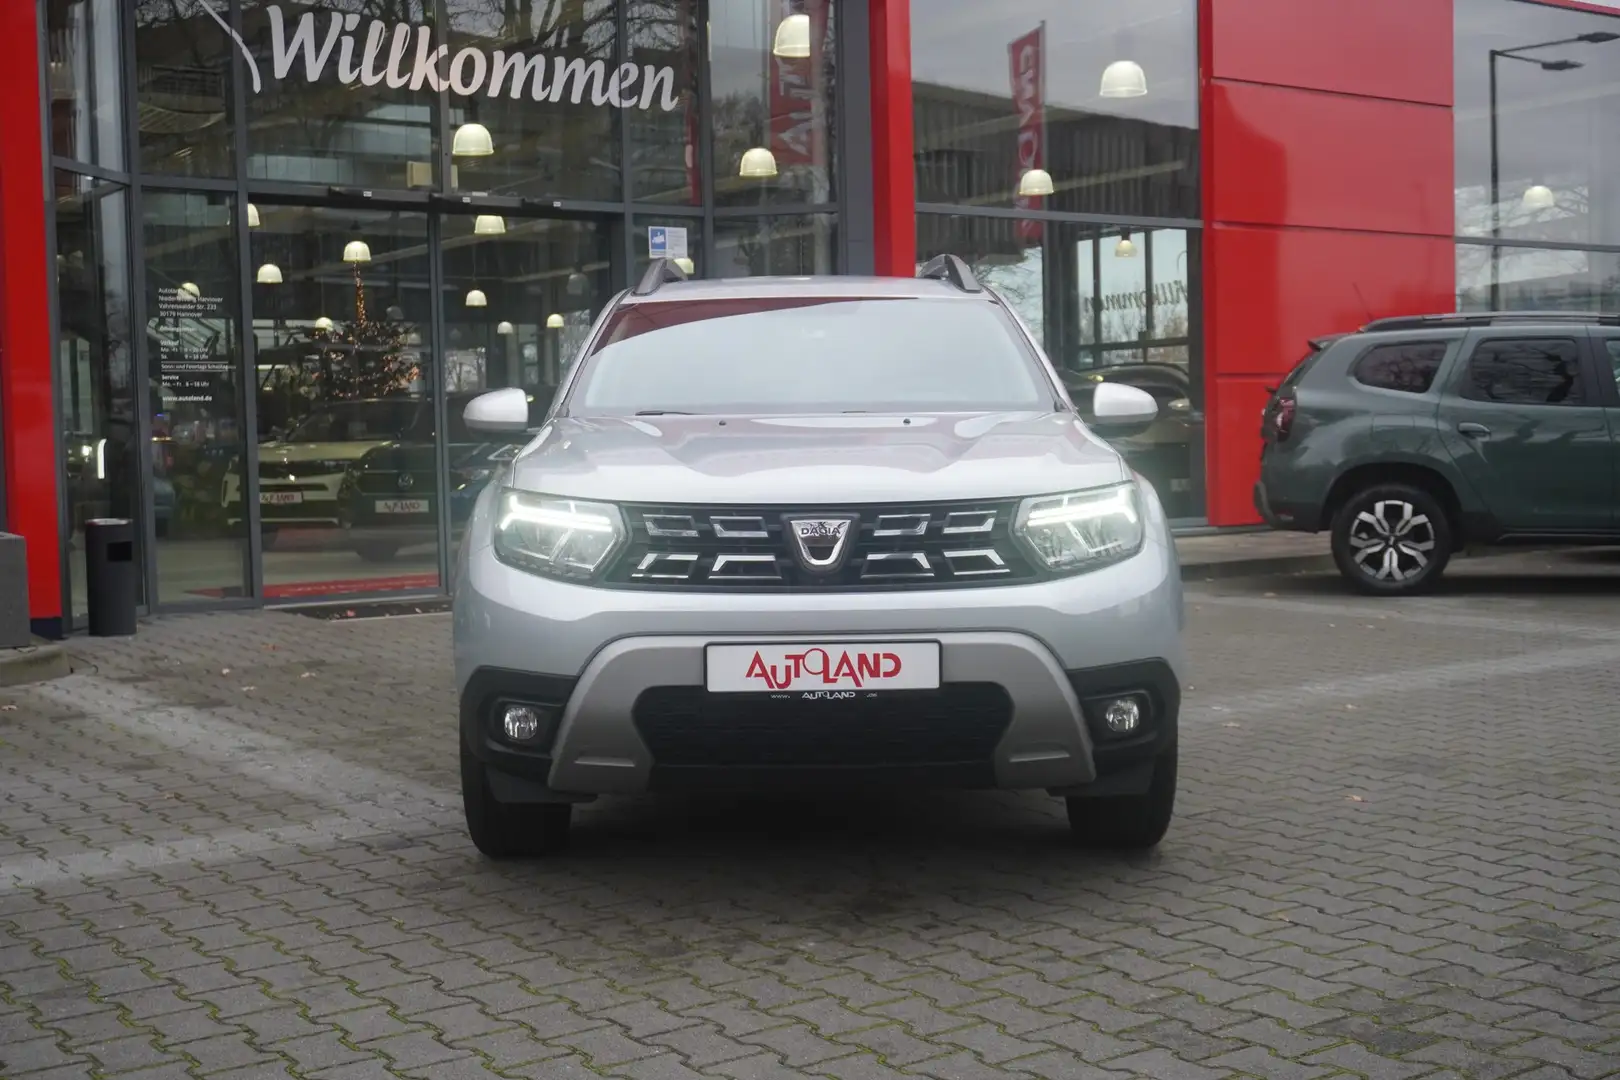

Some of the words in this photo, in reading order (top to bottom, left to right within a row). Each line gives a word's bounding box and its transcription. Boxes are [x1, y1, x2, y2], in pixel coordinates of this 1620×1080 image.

[266, 4, 679, 112] Willkommen
[162, 394, 213, 402] www.autoland.de
[745, 647, 902, 690] AUTOLAND
[802, 690, 856, 700] AUTOLAND
